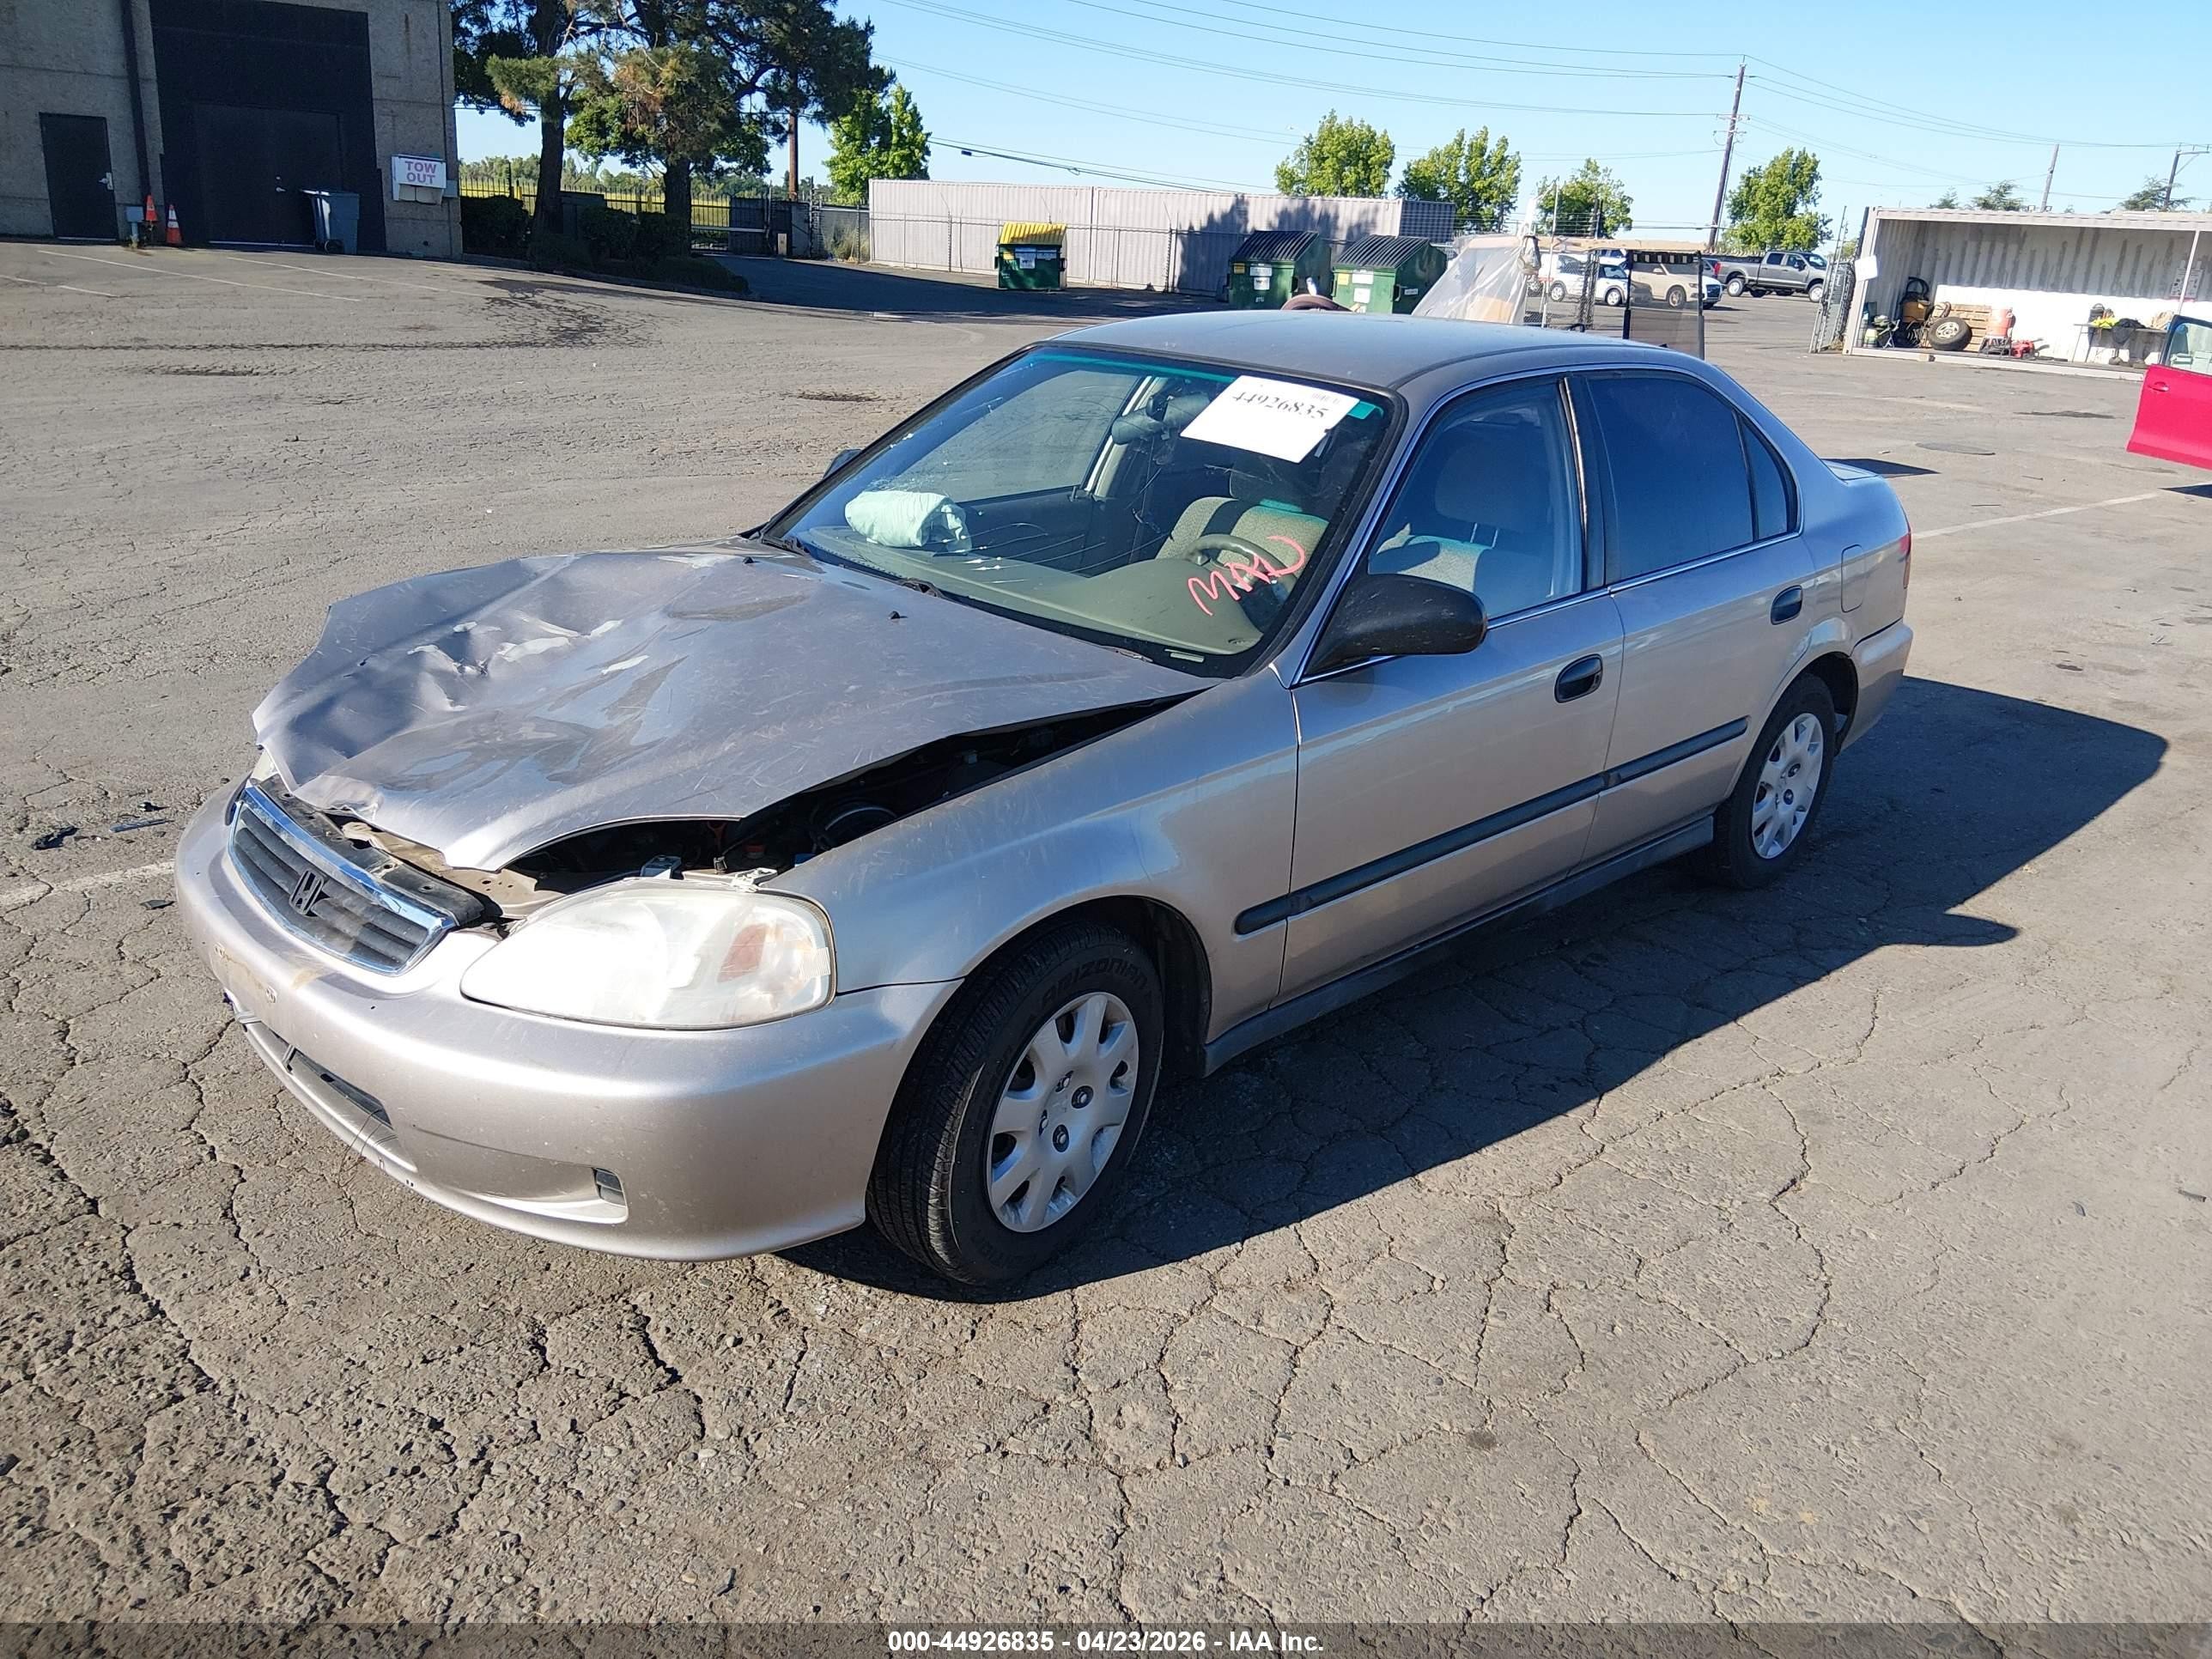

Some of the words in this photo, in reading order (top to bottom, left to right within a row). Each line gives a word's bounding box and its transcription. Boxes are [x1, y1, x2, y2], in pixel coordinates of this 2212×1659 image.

[405, 161, 436, 173] TOW
[406, 172, 435, 184] OUT
[1232, 392, 1329, 418] 44926835
